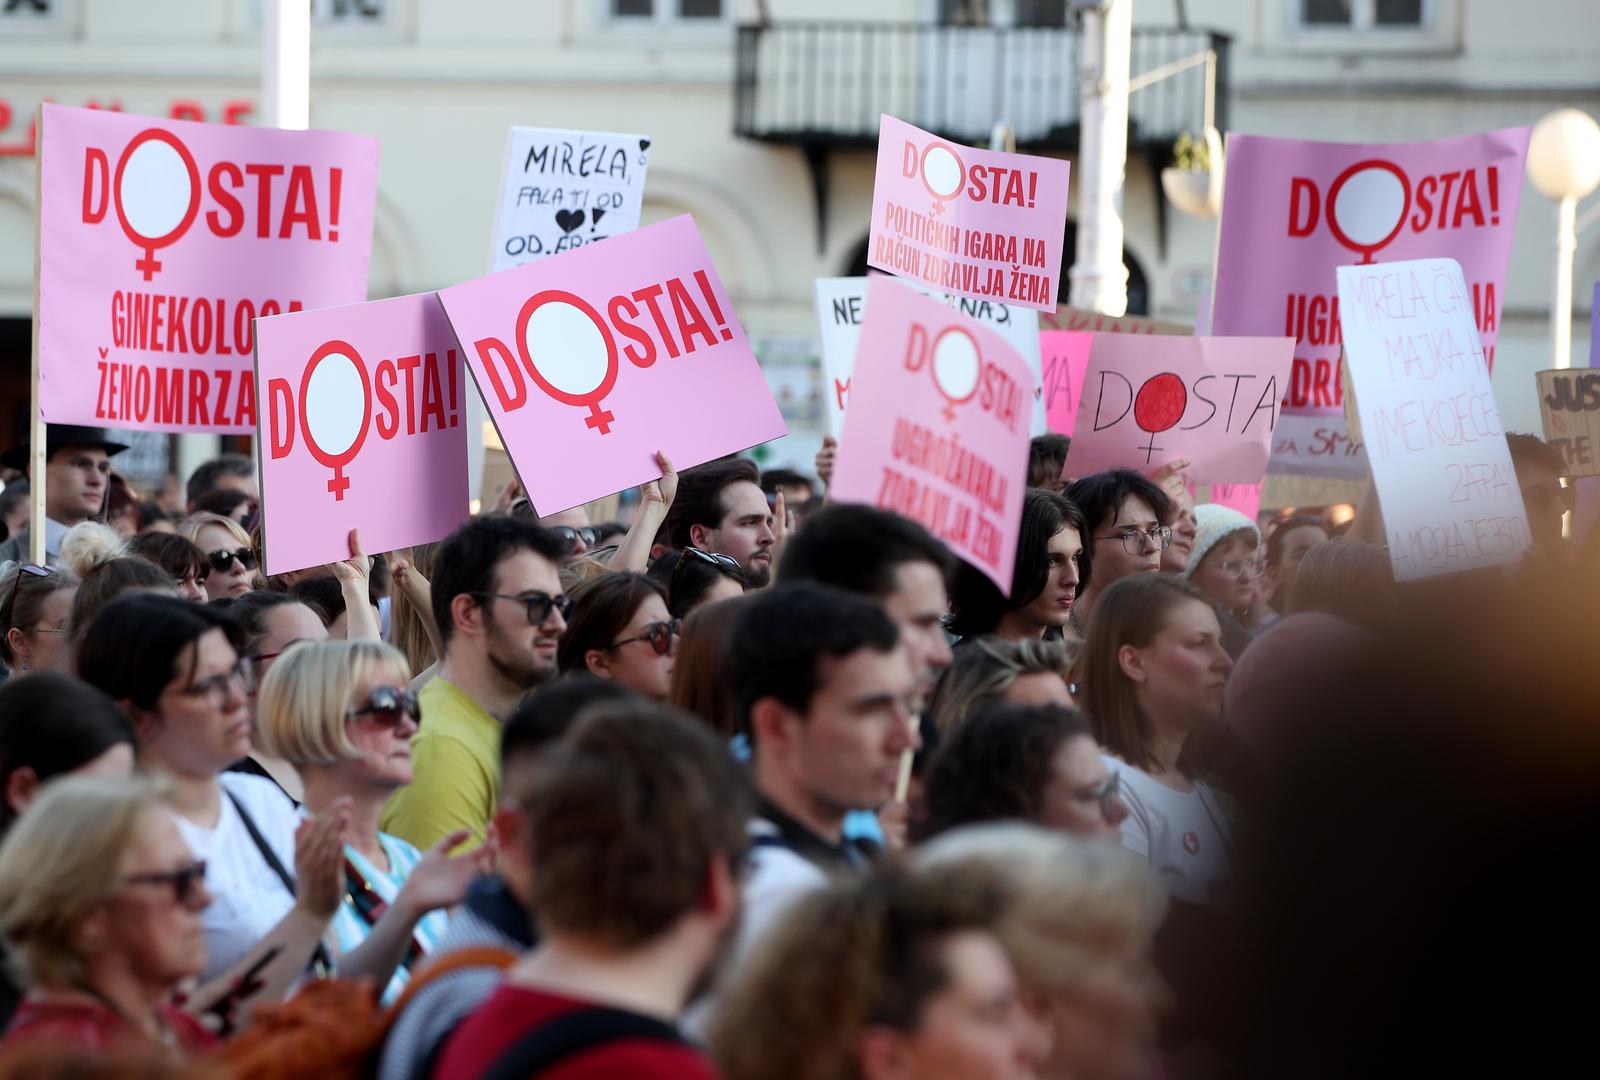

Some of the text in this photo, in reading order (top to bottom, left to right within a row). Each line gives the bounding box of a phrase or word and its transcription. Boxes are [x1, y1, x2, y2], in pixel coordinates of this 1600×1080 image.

[82, 128, 343, 281] DOSTA!
[597, 192, 624, 208] OD
[903, 140, 1038, 215] DOSTA!
[1287, 159, 1500, 264] DOSTA!
[875, 234, 1050, 305] RAČUN ZDRAVLJA ŽENA
[885, 202, 1046, 268] POLITIČKIH IGARA NA
[112, 290, 304, 355] GINEKOLO
[1348, 269, 1430, 326] MIRELA
[474, 270, 734, 435] DOSTA!
[905, 322, 1023, 434] DOSTA!
[1385, 329, 1465, 382] MAJKA
[268, 340, 459, 501] DOSTA!
[1093, 370, 1278, 464] DOSTA
